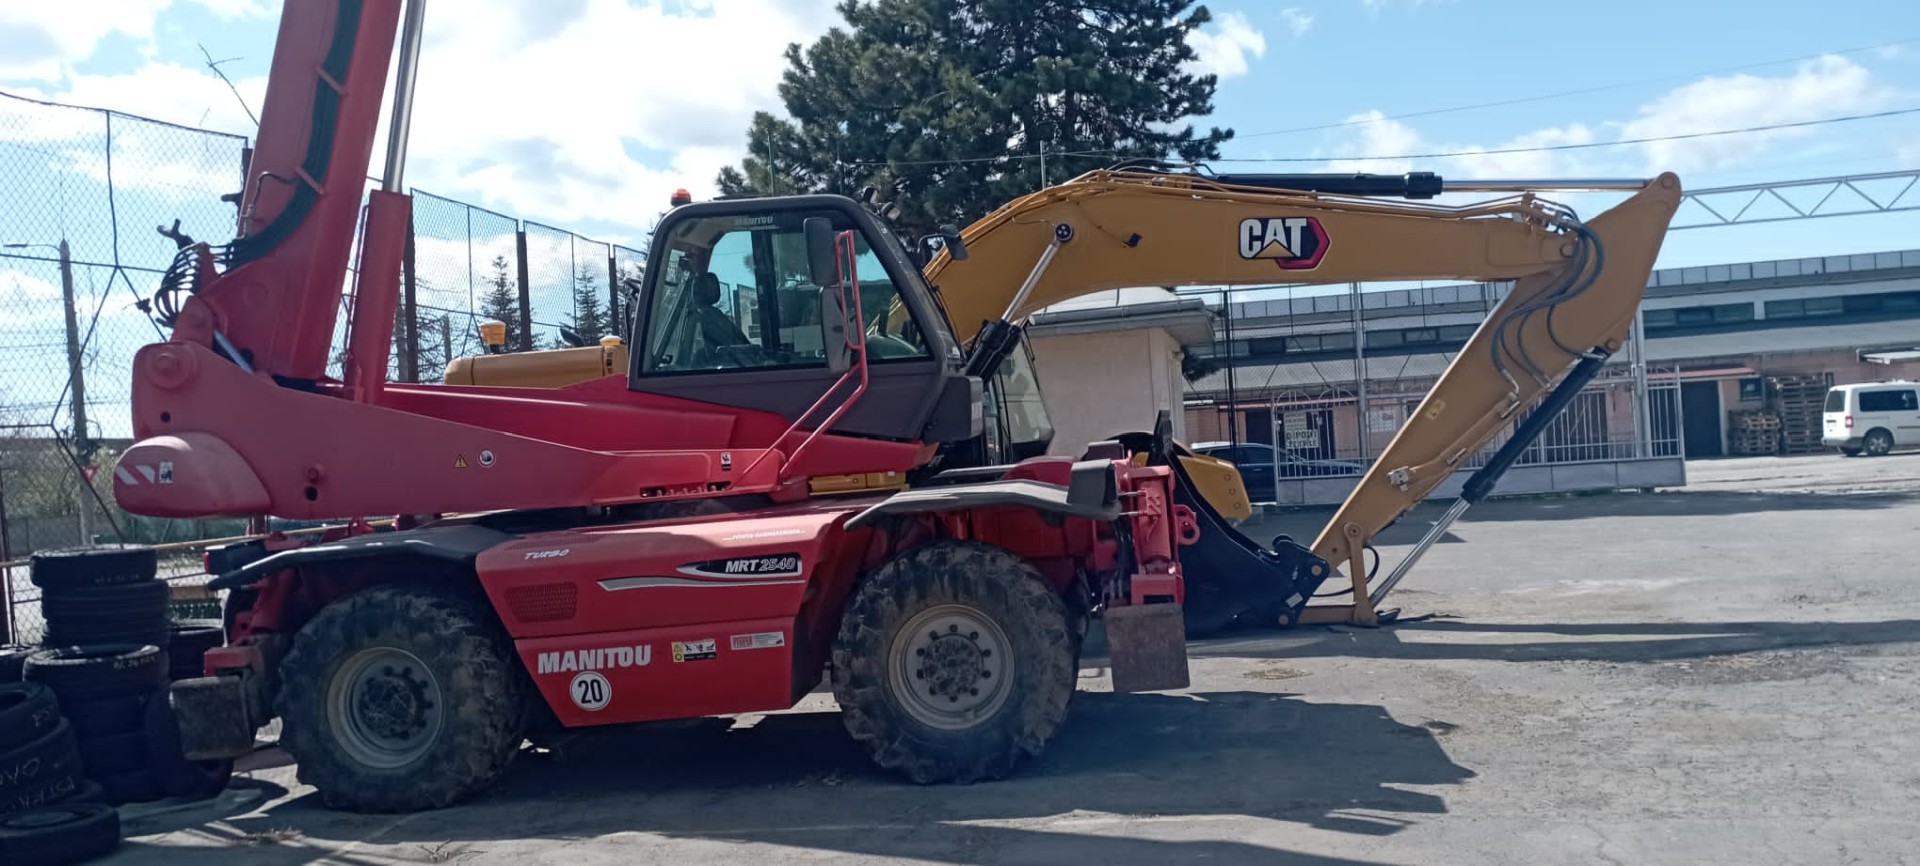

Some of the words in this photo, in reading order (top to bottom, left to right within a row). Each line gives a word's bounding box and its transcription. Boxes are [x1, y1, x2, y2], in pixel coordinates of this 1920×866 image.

[1240, 217, 1308, 258] CAT
[524, 548, 570, 560] TURBO
[725, 559, 757, 573] MRT
[758, 557, 796, 571] 2540
[538, 645, 652, 674] MANITOU
[577, 679, 602, 704] 20
